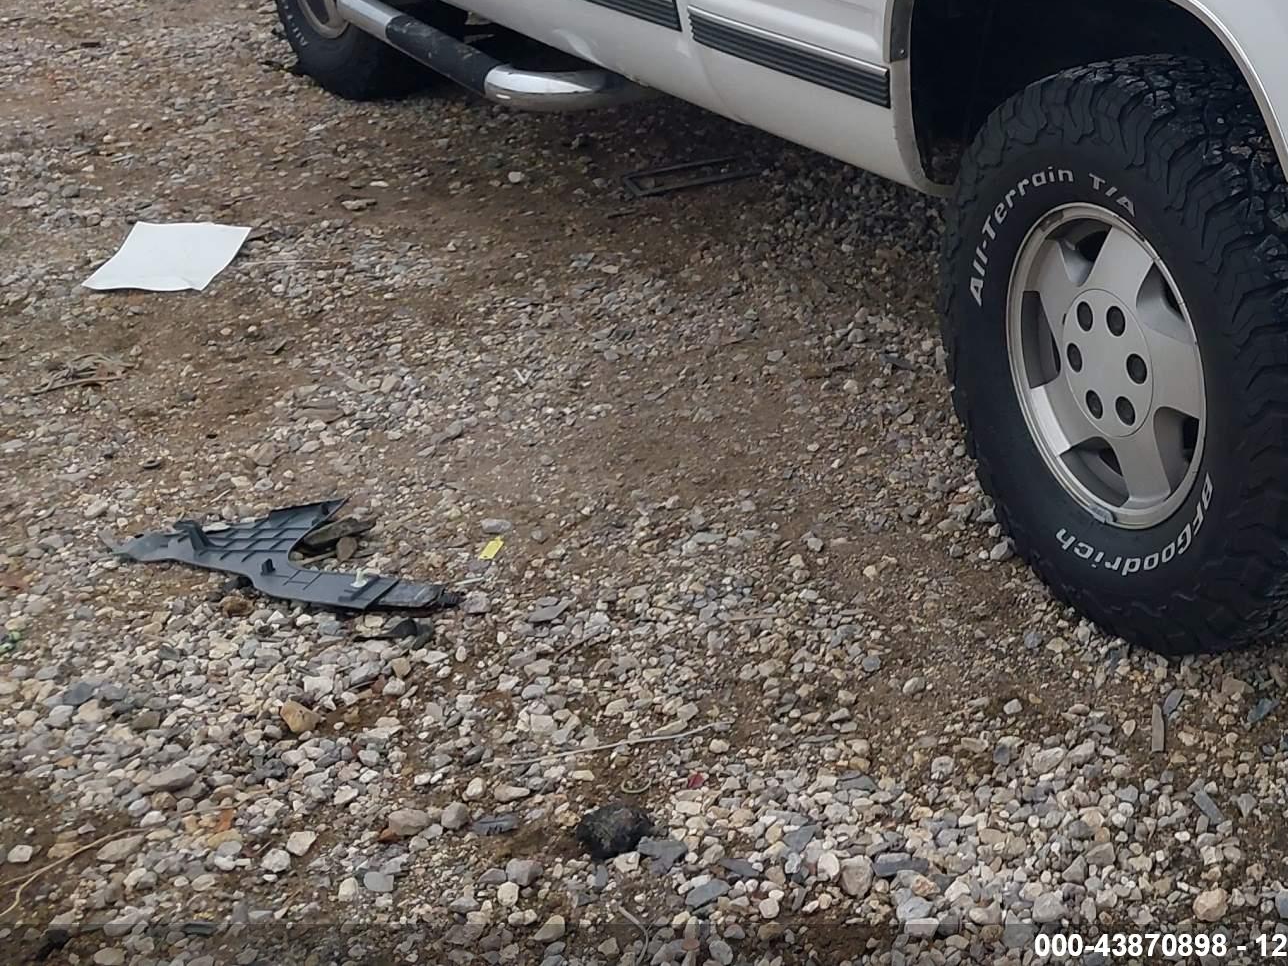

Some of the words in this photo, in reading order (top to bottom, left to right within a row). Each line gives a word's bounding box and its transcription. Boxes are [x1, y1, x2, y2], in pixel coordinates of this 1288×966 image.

[970, 166, 1074, 307] All-Terrain
[1089, 172, 1136, 218] T/A
[1056, 471, 1214, 576] BFGoodrich
